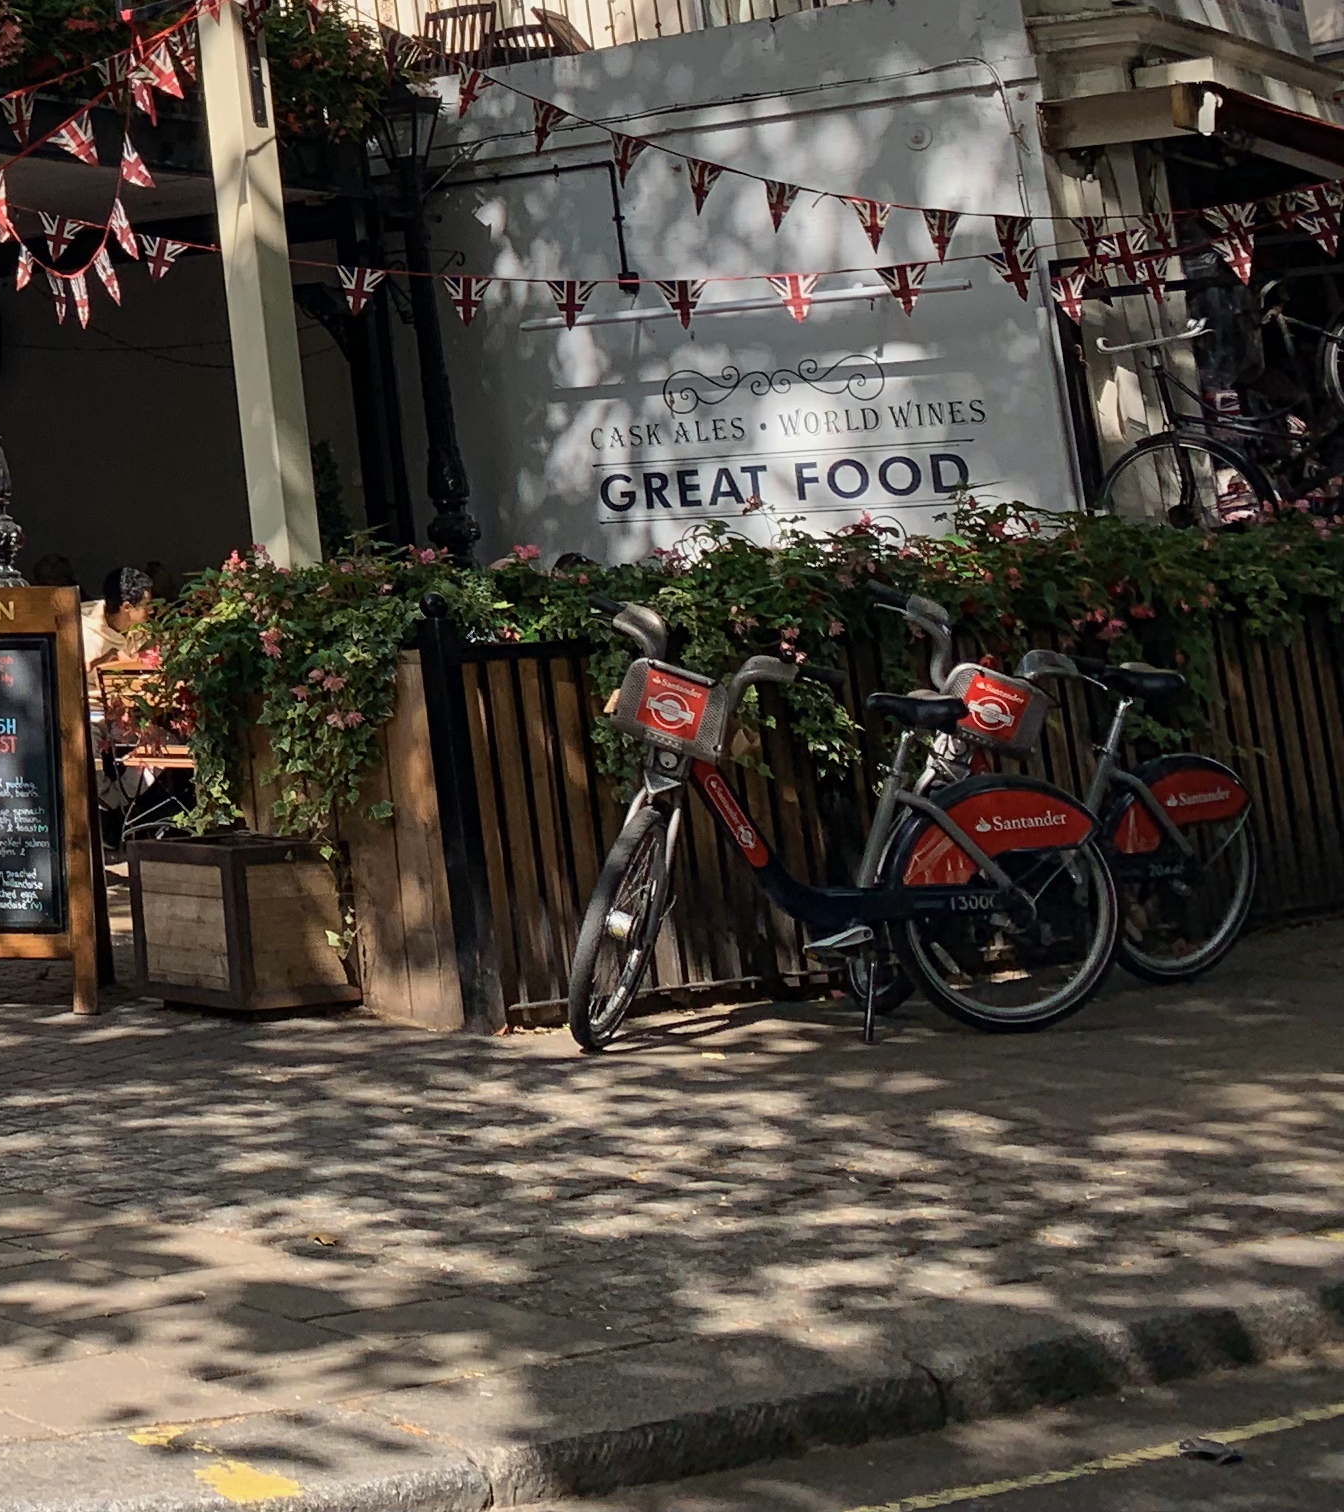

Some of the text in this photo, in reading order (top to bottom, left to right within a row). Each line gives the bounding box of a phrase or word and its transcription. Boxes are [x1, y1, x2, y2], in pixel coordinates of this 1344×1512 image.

[590, 398, 988, 451] CASK ALES WORLD WINES
[600, 453, 970, 512] GREAT FOOD
[661, 678, 703, 699] Santander
[985, 683, 1025, 704] Santander
[714, 787, 742, 826] Santander
[1178, 787, 1231, 807] Santander
[992, 809, 1067, 832] Santander
